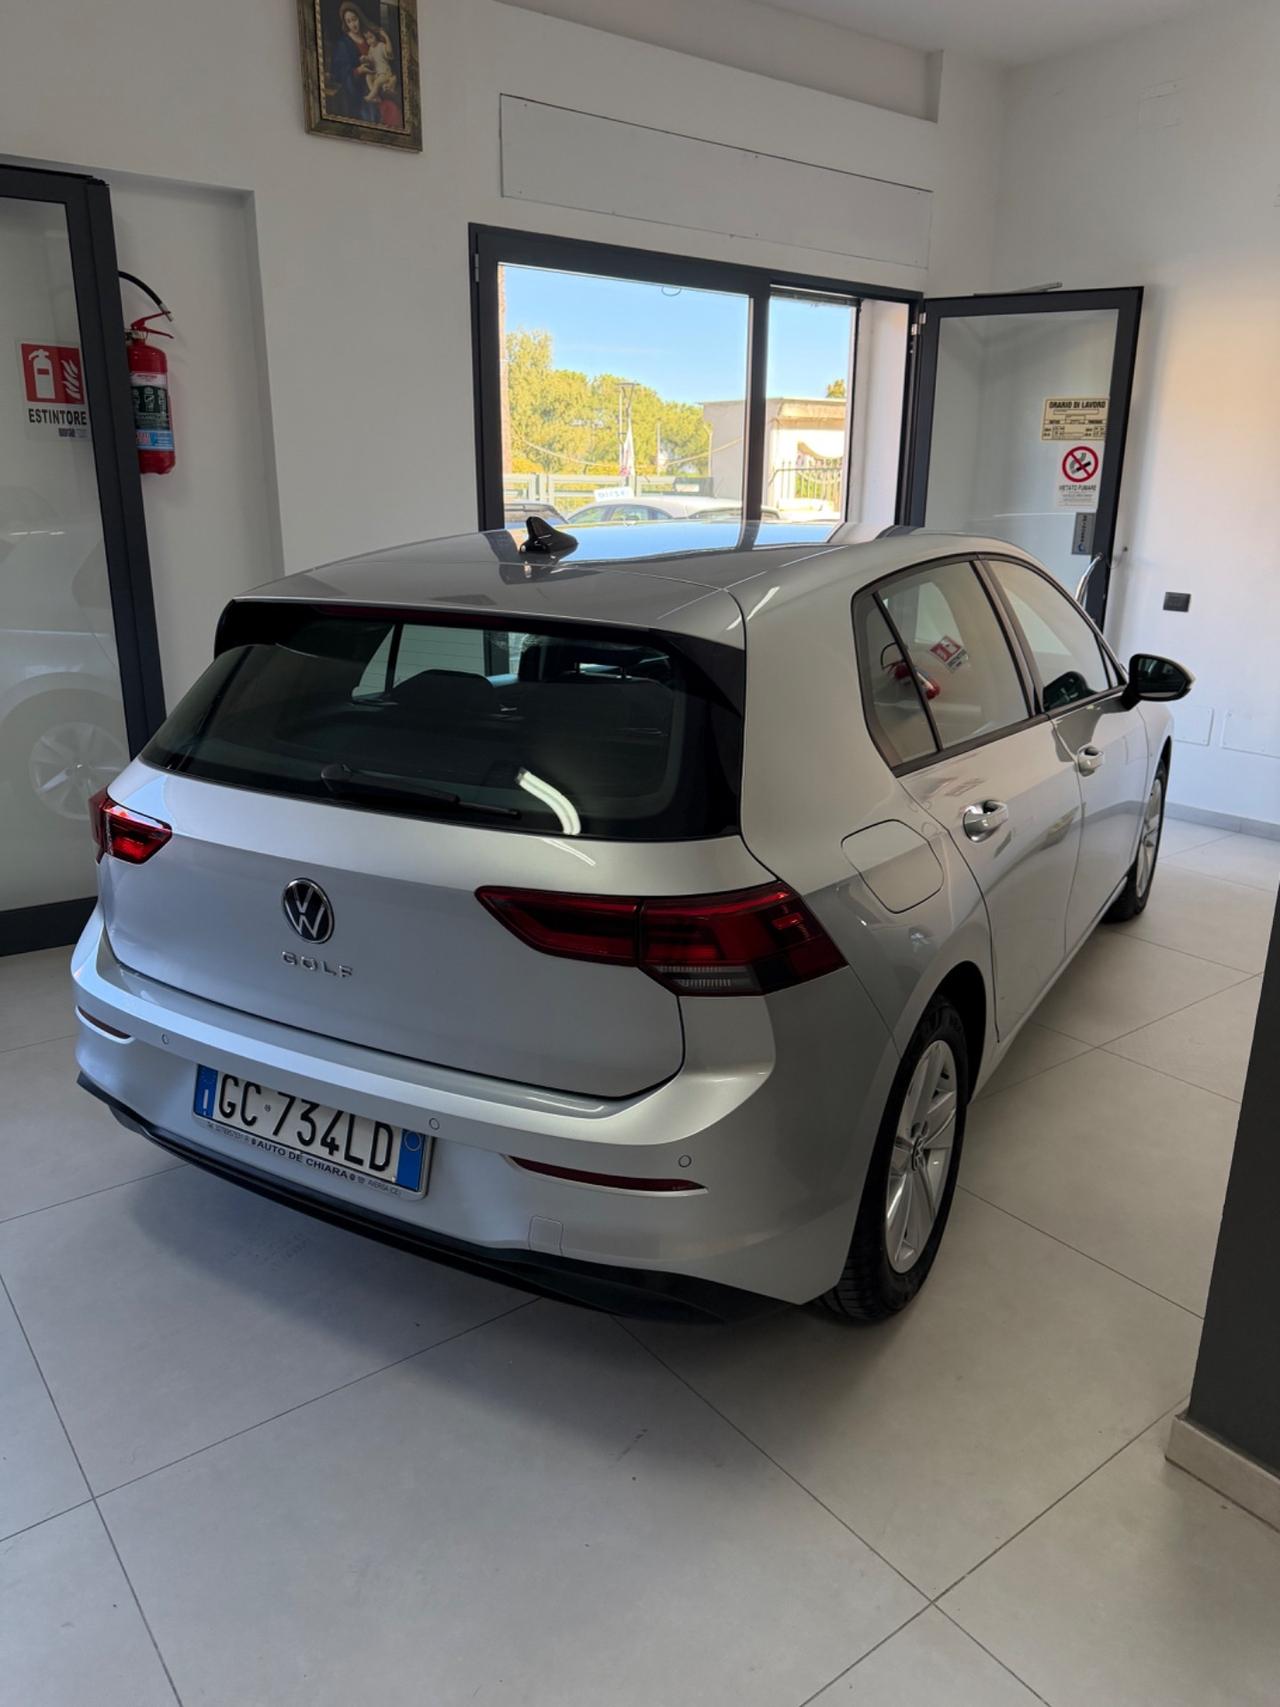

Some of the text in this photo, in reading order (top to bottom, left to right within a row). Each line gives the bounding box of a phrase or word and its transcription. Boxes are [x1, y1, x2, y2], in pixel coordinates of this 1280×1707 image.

[1049, 401, 1072, 409] ORARIO
[28, 408, 87, 426] ESTINTORE
[281, 951, 354, 979] GOLF
[256, 1140, 286, 1156] AUTO
[288, 1151, 303, 1163] DE
[305, 1158, 348, 1178] CHIARA
